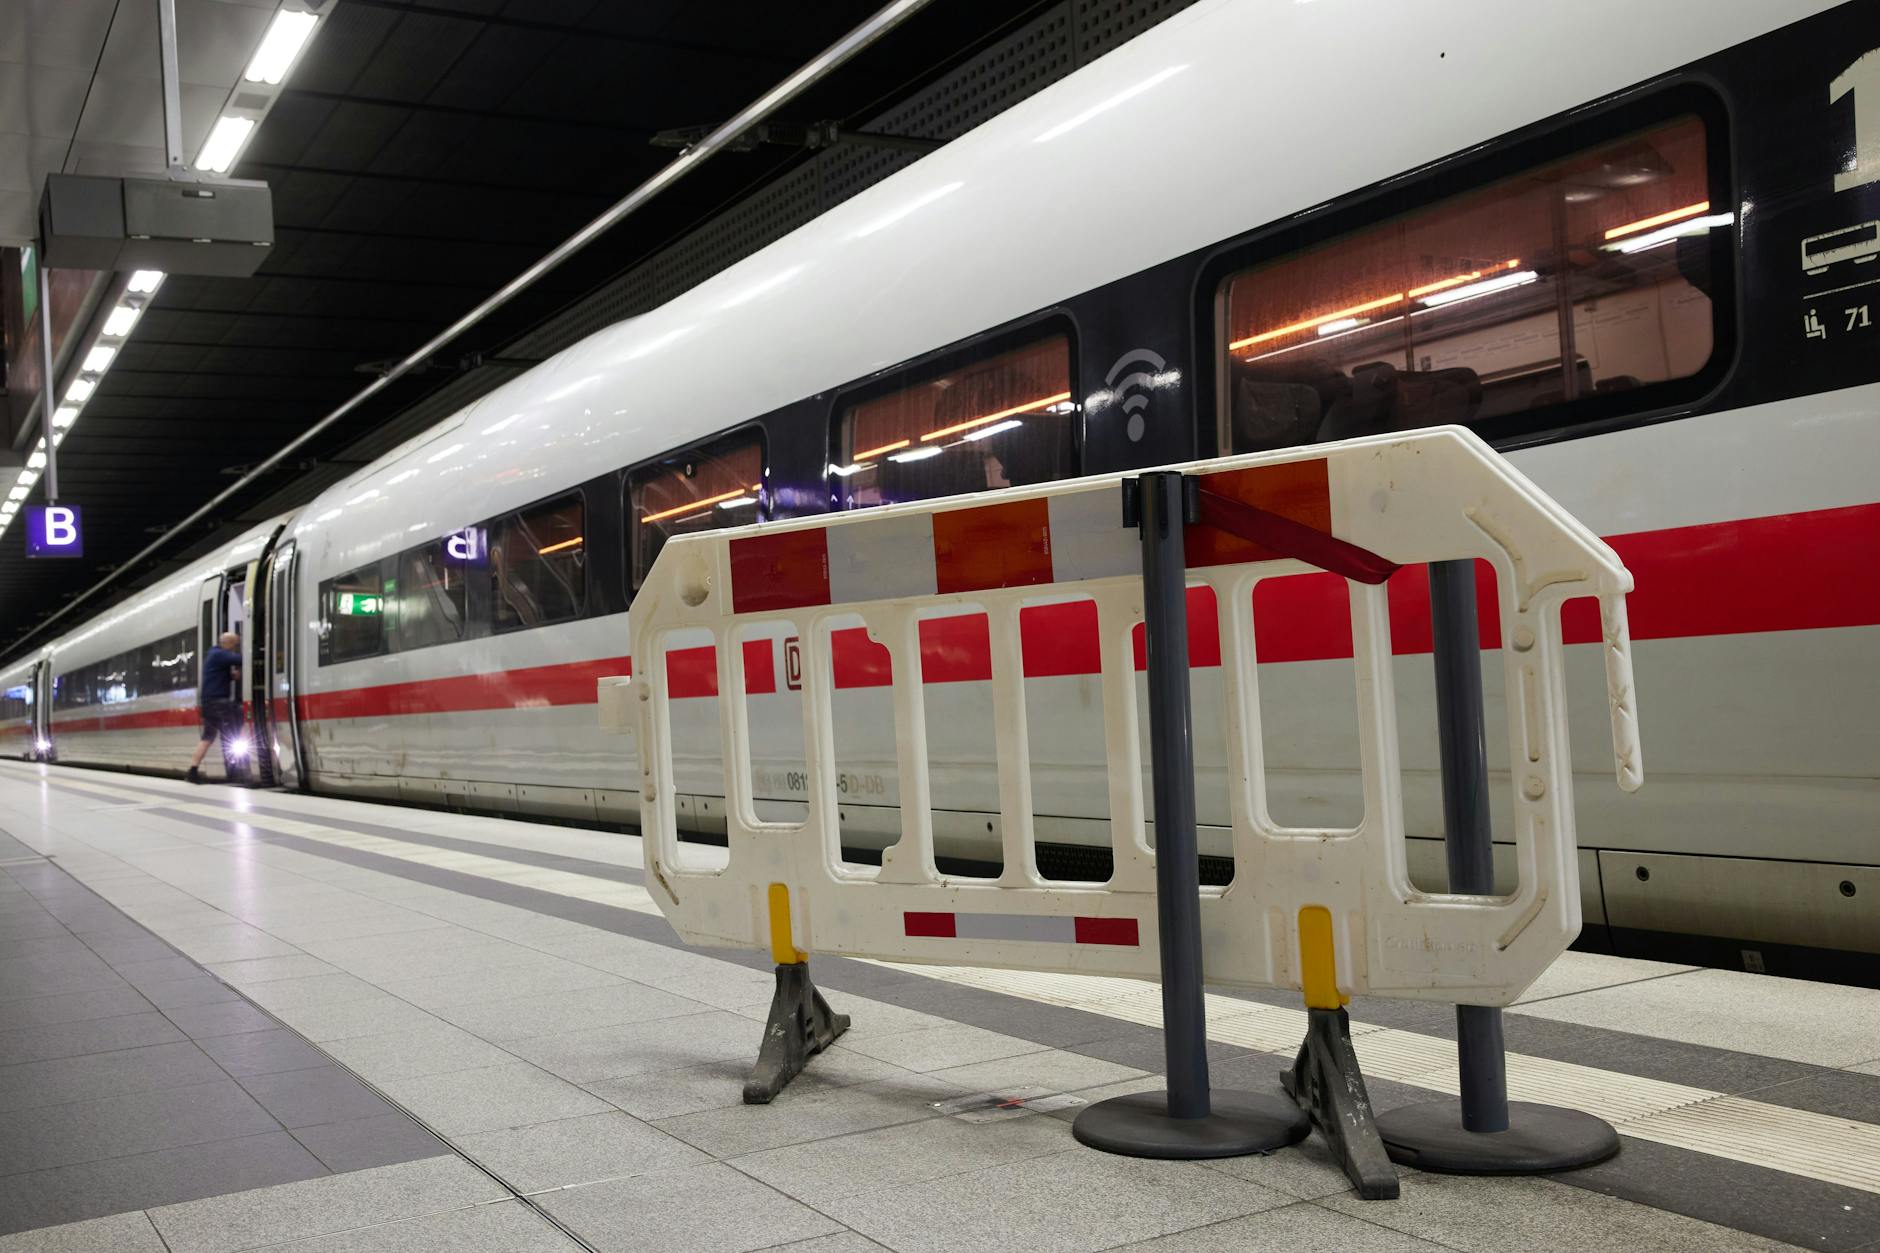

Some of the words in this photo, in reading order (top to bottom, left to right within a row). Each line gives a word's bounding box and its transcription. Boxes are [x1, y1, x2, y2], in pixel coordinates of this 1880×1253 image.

[1845, 305, 1872, 331] 71
[45, 506, 77, 546] B
[787, 772, 808, 791] 081
